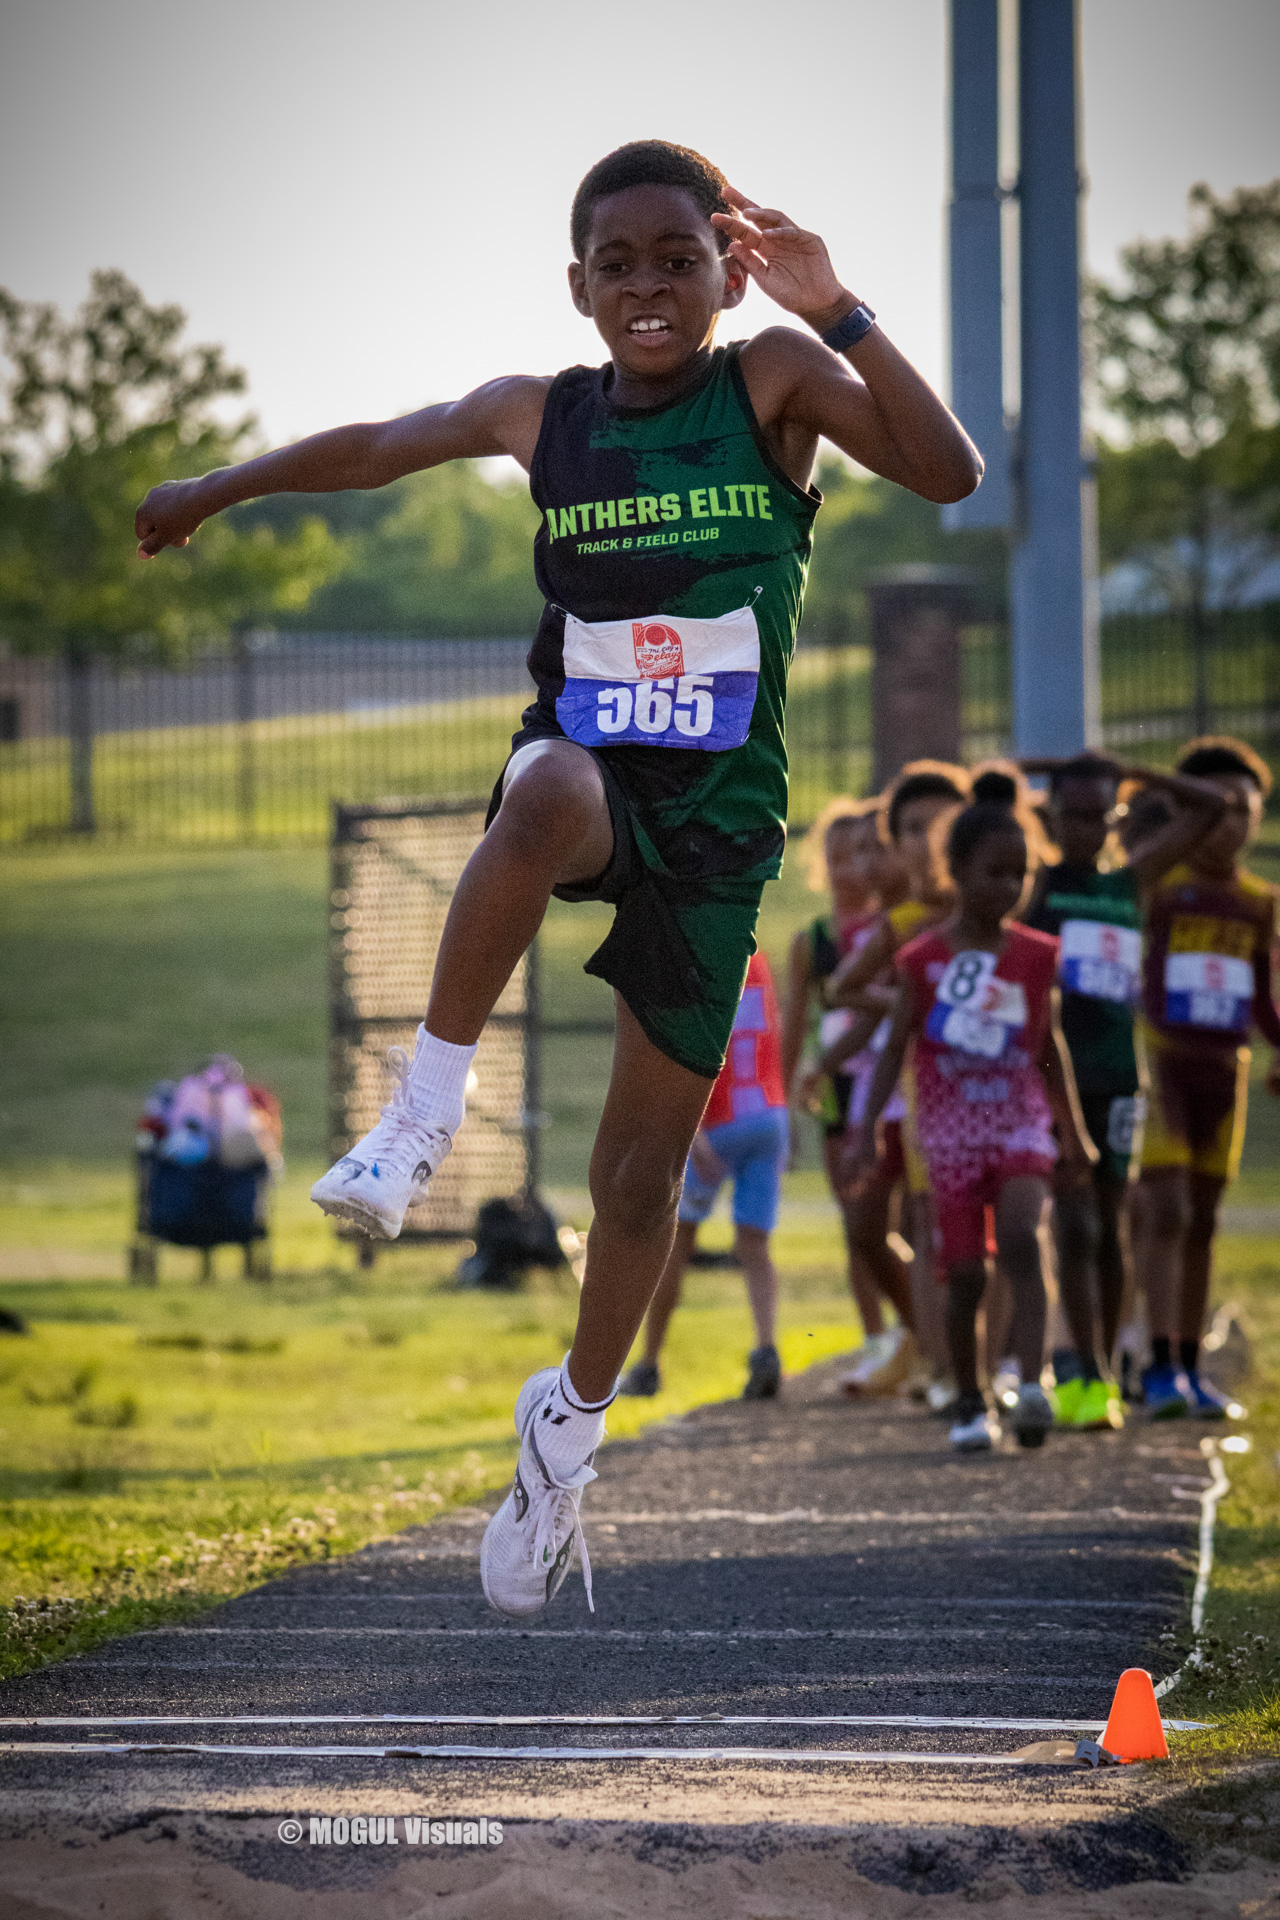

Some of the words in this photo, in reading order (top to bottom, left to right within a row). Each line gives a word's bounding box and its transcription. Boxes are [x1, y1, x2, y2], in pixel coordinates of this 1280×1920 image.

[689, 484, 773, 520] ELITE
[577, 538, 619, 555] TRACK
[622, 537, 633, 549] &
[636, 532, 679, 548] FIELD
[682, 527, 720, 542] CLUB
